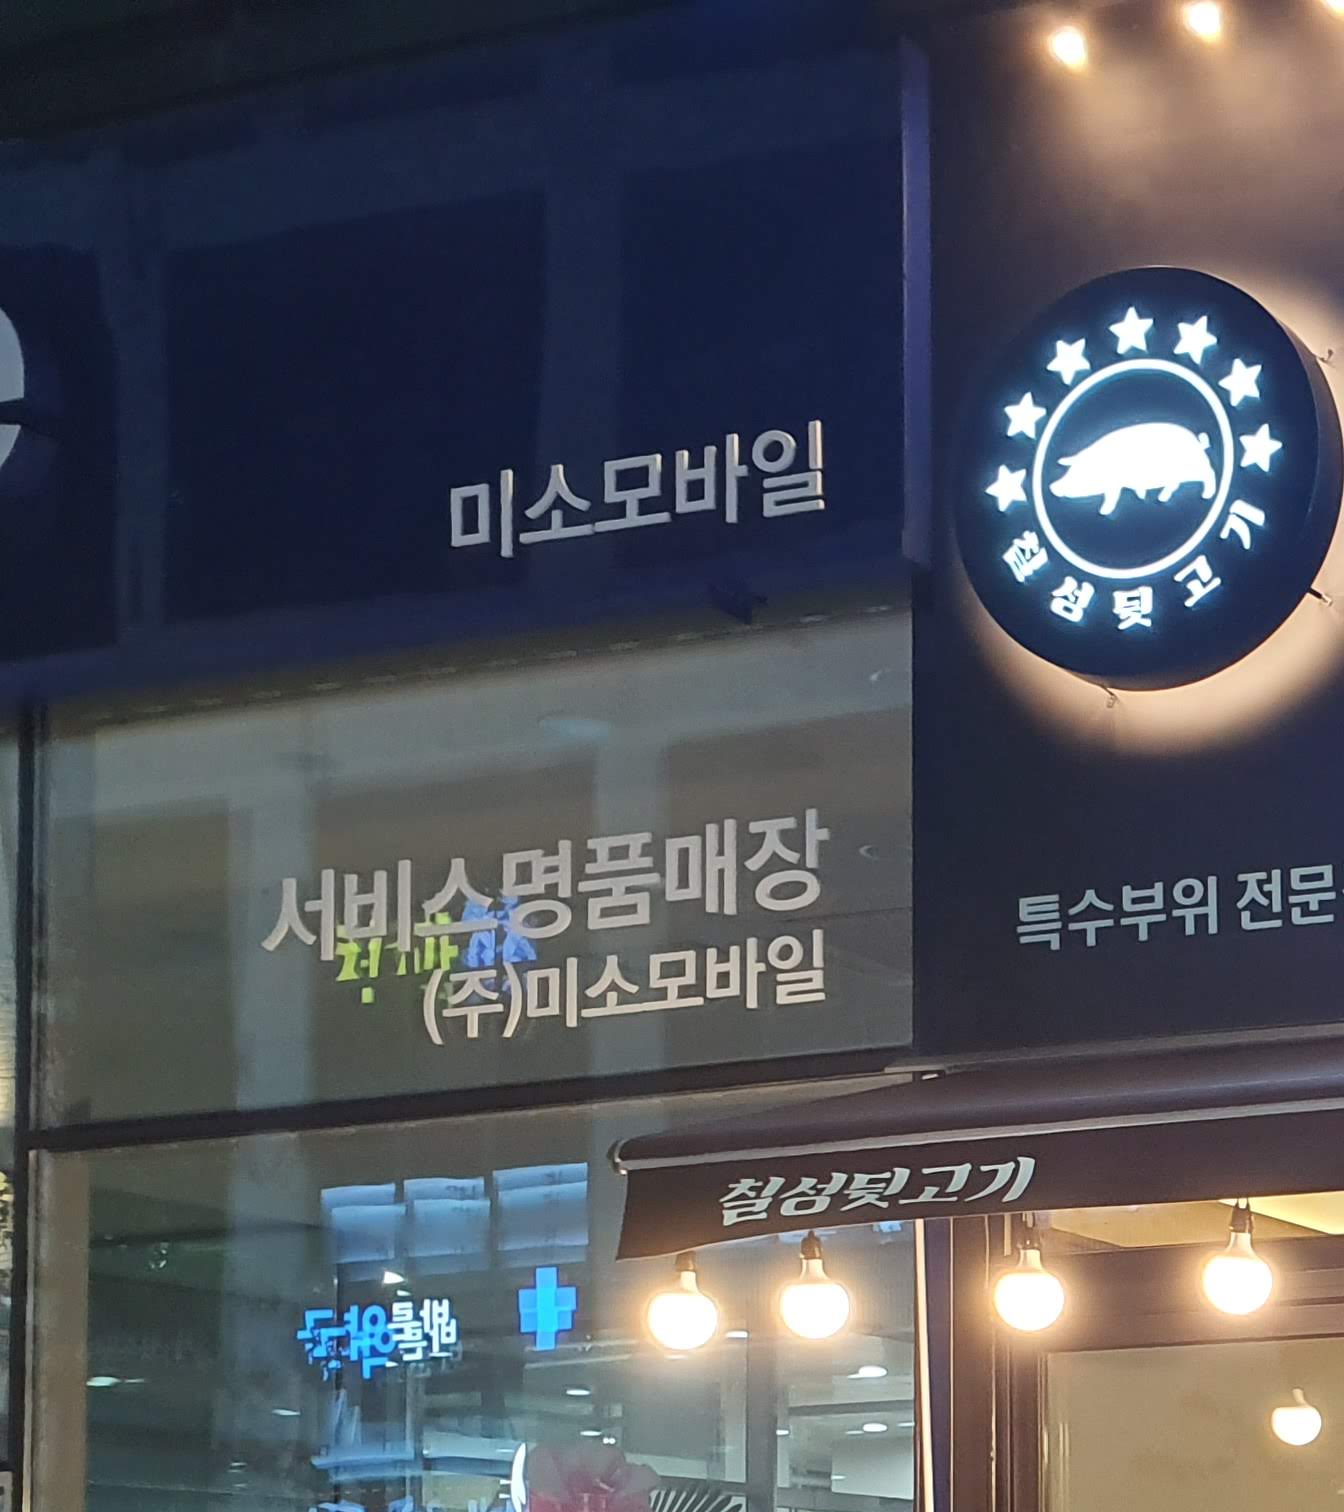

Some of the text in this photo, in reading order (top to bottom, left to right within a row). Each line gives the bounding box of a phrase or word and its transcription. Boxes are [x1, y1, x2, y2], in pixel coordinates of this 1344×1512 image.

[450, 419, 826, 558] 미소모바일
[1001, 497, 1266, 631] 칠성뒷고기
[262, 808, 829, 961] 서비스명품매장
[1016, 875, 1218, 951] 특수부위
[423, 929, 826, 1045] (주)미소모바일
[718, 1155, 1038, 1227] 칠성뒷고기
